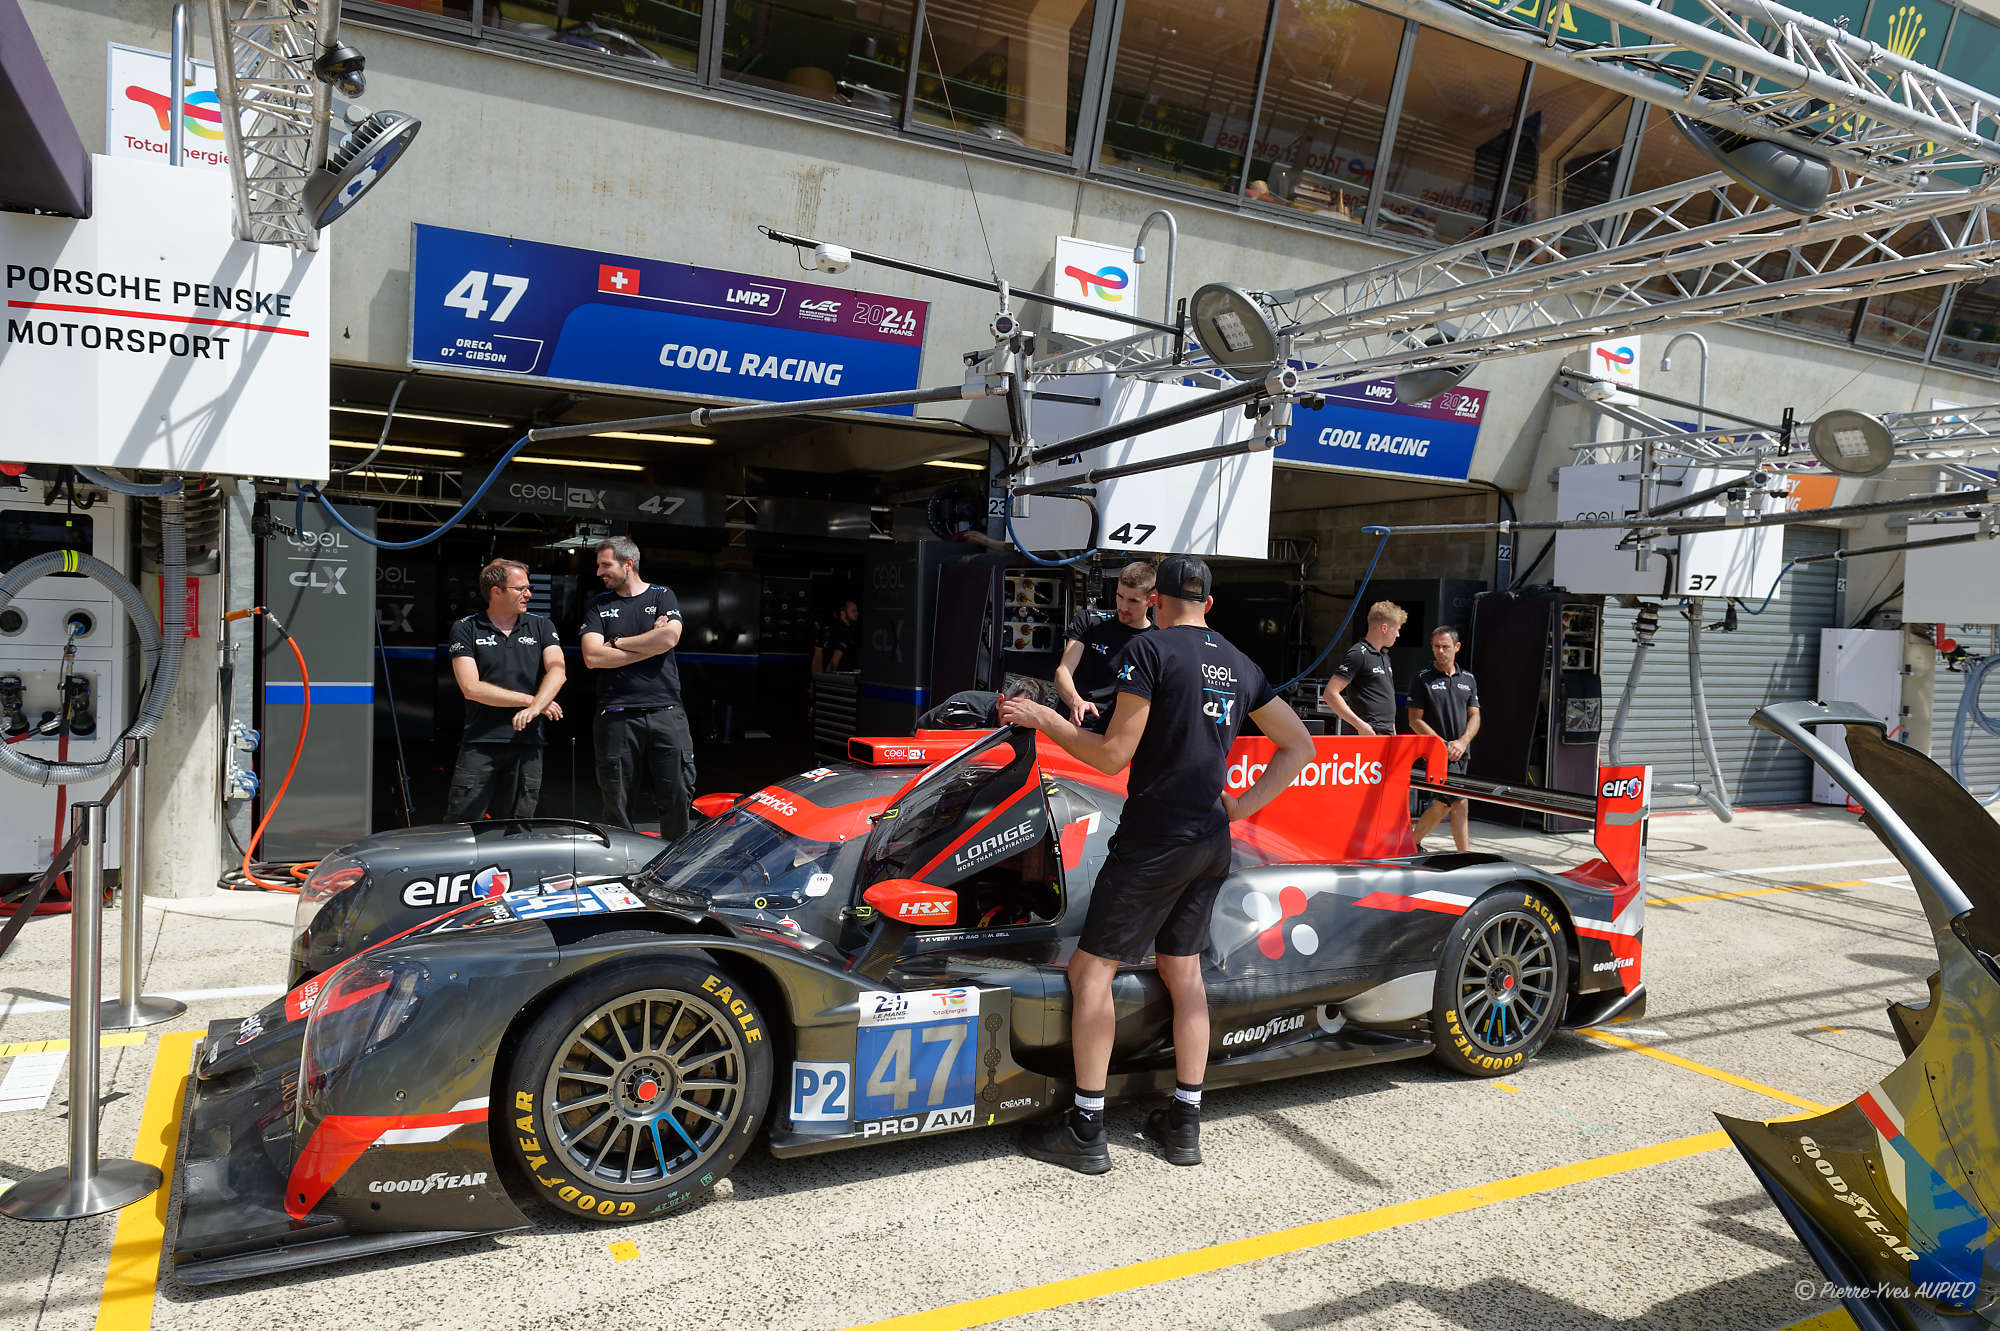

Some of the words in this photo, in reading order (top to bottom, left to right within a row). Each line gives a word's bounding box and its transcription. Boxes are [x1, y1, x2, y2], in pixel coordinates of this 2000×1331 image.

[124, 135, 230, 166] Totalnergie
[7, 264, 161, 302] PORSCHE
[173, 281, 291, 318] PENSKE
[443, 269, 530, 323] 47
[726, 288, 771, 308] LMP2
[799, 299, 842, 313] WEC
[7, 318, 230, 360] MOTORSPORT
[878, 326, 888, 334] LE
[889, 328, 914, 337] MANS
[441, 347, 455, 357] 07
[465, 350, 507, 363] GIBSON
[455, 338, 493, 351] ORECA
[659, 342, 732, 374] COOL
[739, 352, 844, 386] RACING
[1365, 385, 1393, 399] LMP2
[1318, 427, 1362, 450] COOL
[1365, 433, 1431, 458] RACING
[509, 483, 563, 501] COOL
[567, 487, 608, 510] CLX
[637, 495, 686, 515] 47
[989, 500, 1006, 515] 23
[287, 531, 349, 549] COOL
[1108, 522, 1157, 545] 47
[1498, 546, 1511, 560] 22
[288, 566, 348, 595] CLX
[375, 567, 416, 584] OOL
[1688, 574, 1717, 591] 37
[377, 603, 415, 633] LX
[600, 608, 620, 619] CLX
[475, 634, 498, 647] CLX
[1201, 663, 1238, 683] COOL
[1207, 679, 1231, 688] RACING
[1431, 681, 1447, 690] CLX
[1203, 697, 1235, 726] CLX
[884, 749, 908, 758] COOL
[1226, 752, 1383, 789] dabricks
[1602, 779, 1628, 797] elf
[957, 861, 975, 872] MORE
[976, 852, 993, 864] THAN
[994, 832, 1035, 855] INSPIRATION
[402, 873, 469, 907] elf
[899, 900, 953, 915] HRX
[1523, 893, 1561, 935] EAGLE
[1593, 956, 1635, 973] GOODYEAR
[700, 973, 762, 1044] EAGLE
[932, 1007, 968, 1016] TotalEnergies
[1222, 1013, 1305, 1046] GOODYEAR
[1445, 1009, 1526, 1070] GOODYEAR
[865, 1024, 968, 1111] 47
[794, 1068, 847, 1114] P2
[862, 1117, 919, 1139] PRO
[931, 1110, 973, 1129] AM
[516, 1090, 637, 1218] GOODYEAR
[368, 1171, 488, 1194] GOODYEAR
[1800, 1135, 1920, 1263] GOODYEAR
